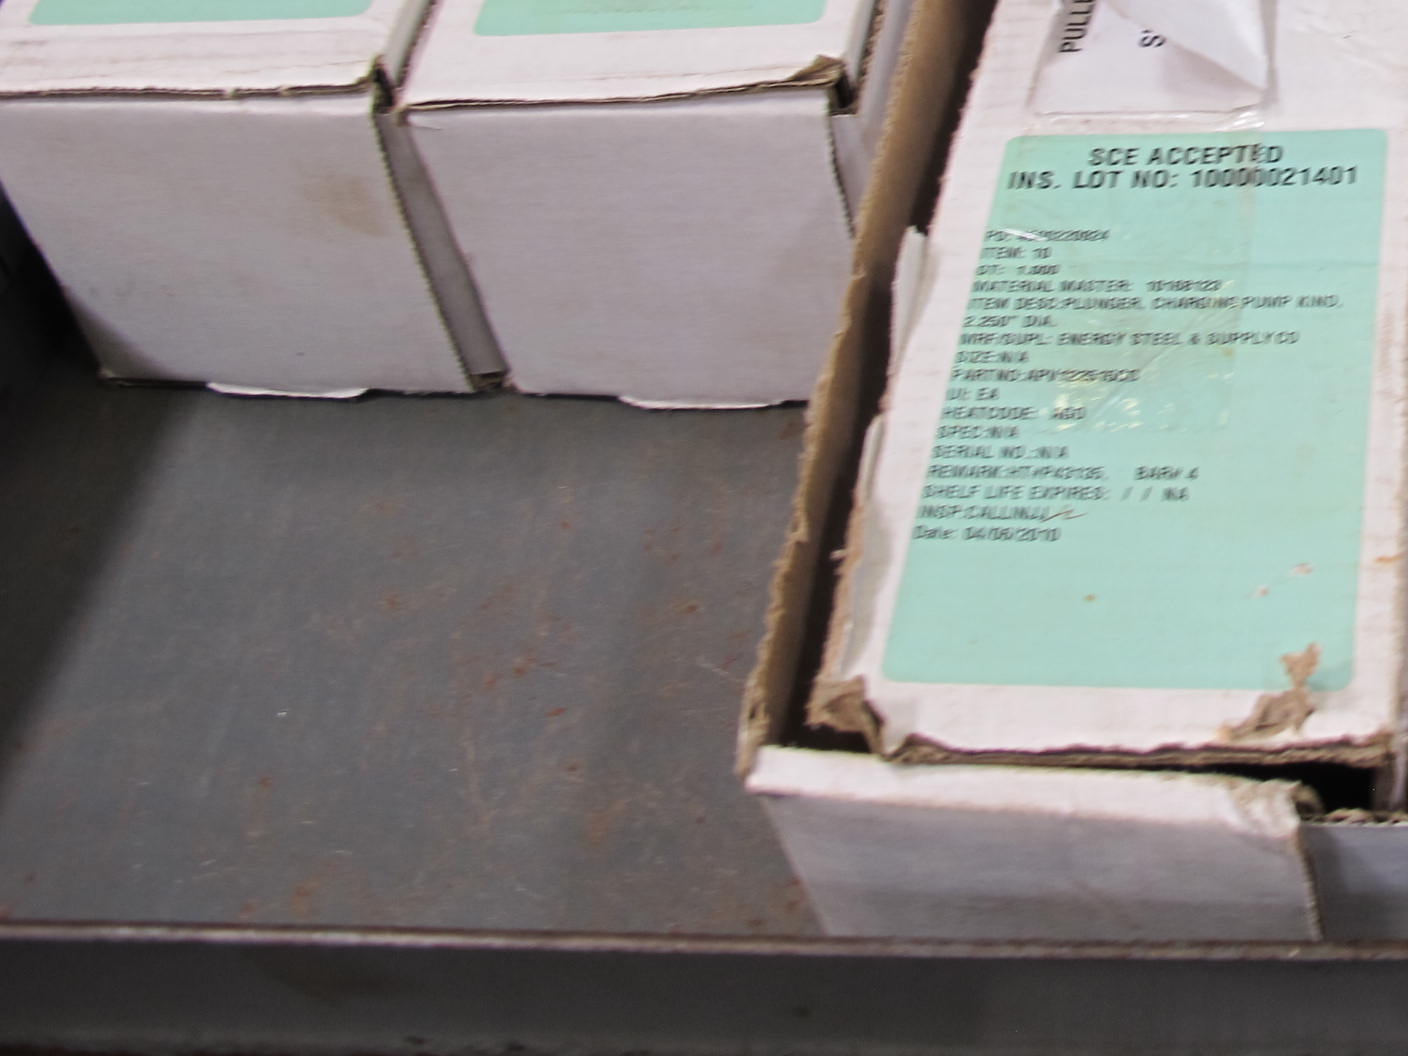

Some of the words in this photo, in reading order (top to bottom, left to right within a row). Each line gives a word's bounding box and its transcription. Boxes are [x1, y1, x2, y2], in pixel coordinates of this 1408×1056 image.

[1088, 147, 1139, 166] SCE
[1147, 144, 1283, 166] ACCEPTED
[1007, 170, 1059, 189] INS.
[1072, 170, 1121, 188] LOT
[1131, 169, 1179, 187] NO:
[1191, 166, 1358, 188] 10000021401
[982, 247, 1023, 259] ITEM:
[973, 280, 1053, 292] MATERIAL
[1061, 279, 1131, 292] MASTER:
[966, 297, 1010, 310] ITEM
[1153, 295, 1241, 310] CHARGING
[1242, 294, 1290, 309] PUMP
[1059, 332, 1127, 345] ENERGY
[1132, 332, 1183, 344] STEEL
[1191, 333, 1200, 344] &
[1207, 331, 1275, 344] SUPPLY
[1278, 330, 1299, 344] CO
[977, 388, 999, 400] EA
[943, 406, 1038, 420] HEATCODE:
[933, 445, 995, 458] SERIAL
[923, 485, 980, 499] SHELF
[985, 485, 1024, 499] LIFE
[913, 526, 954, 540] Date:
